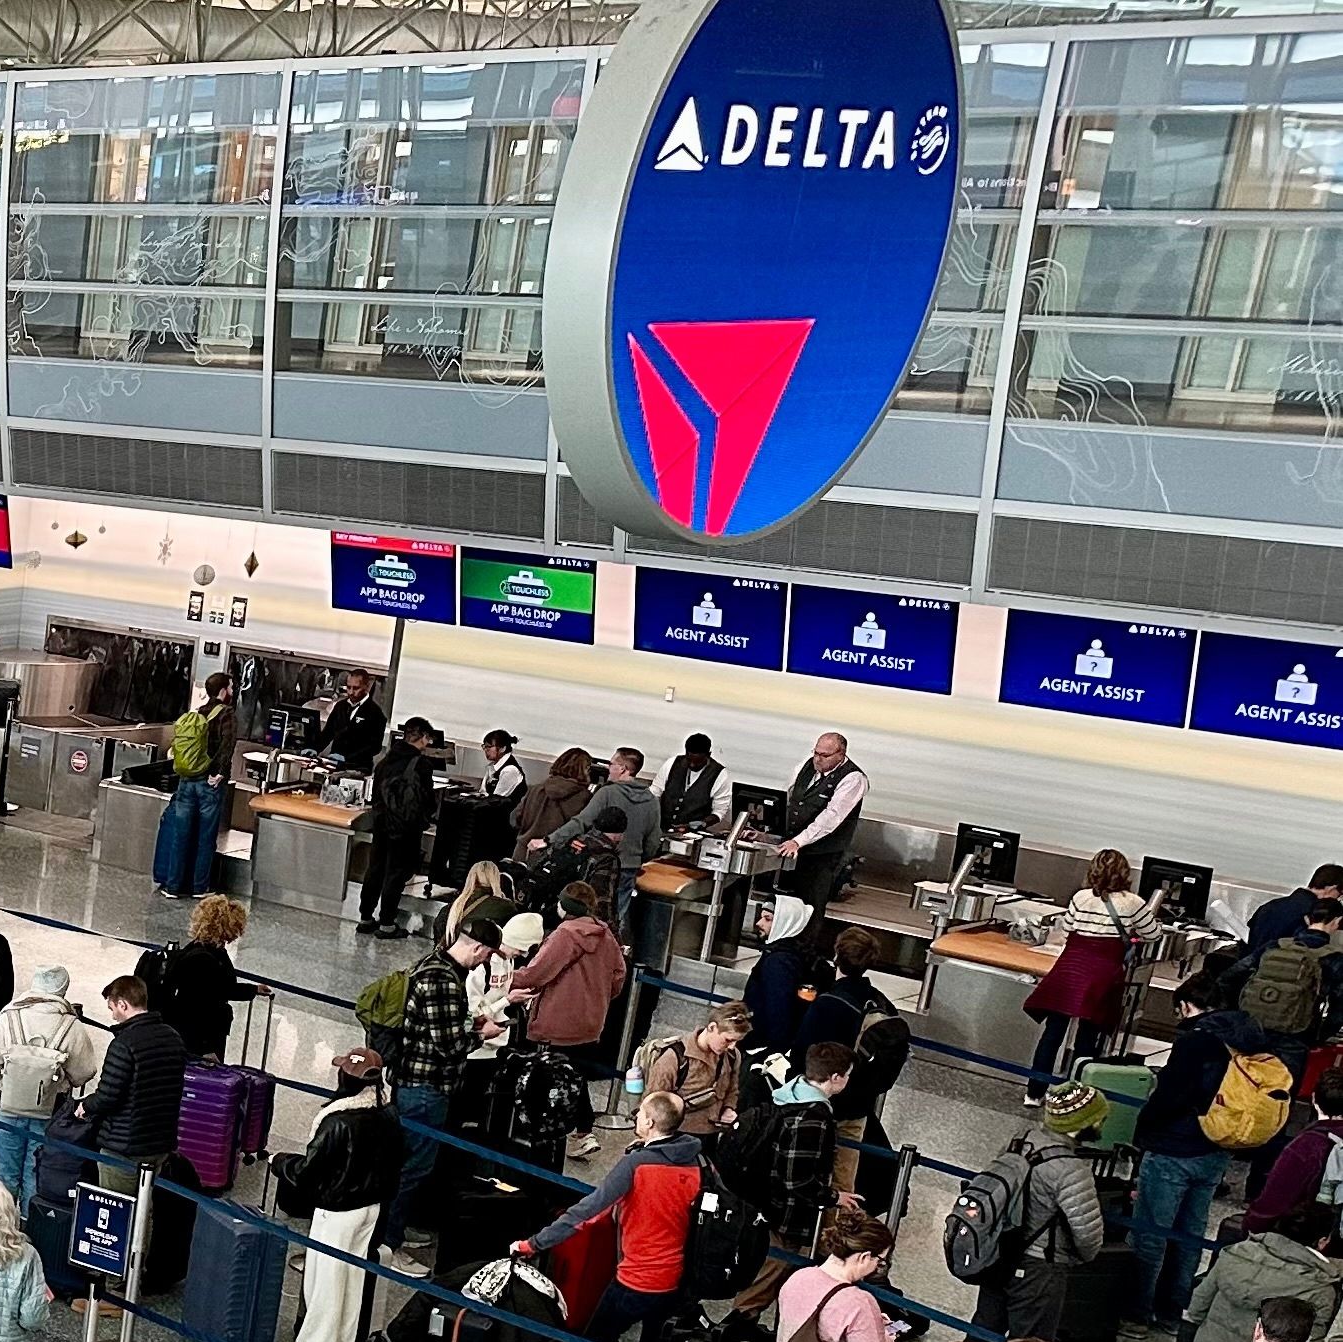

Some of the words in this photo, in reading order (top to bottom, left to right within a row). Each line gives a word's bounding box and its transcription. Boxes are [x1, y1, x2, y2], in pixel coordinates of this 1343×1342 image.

[721, 104, 895, 170] DELTA
[419, 542, 443, 551] DELTA
[556, 559, 582, 567] DELTA
[511, 586, 549, 597] TOUCHLESS
[743, 580, 771, 590] DELTA
[360, 587, 377, 597] APP
[379, 589, 397, 600] BAG
[400, 592, 425, 603] DROP
[909, 598, 941, 609] DELTA
[491, 604, 509, 614] APP
[511, 606, 531, 618] BAG
[534, 609, 561, 621] DROP
[665, 627, 704, 645] AGENT
[708, 631, 749, 649] ASSIST
[1140, 625, 1176, 637] DELTA
[822, 648, 865, 667] AGENT
[869, 652, 915, 672] ASSIST
[1040, 677, 1088, 696] AGENT
[1093, 683, 1145, 703] ASSIST
[1235, 703, 1290, 724] AGENT
[1295, 708, 1343, 728] ASSIS
